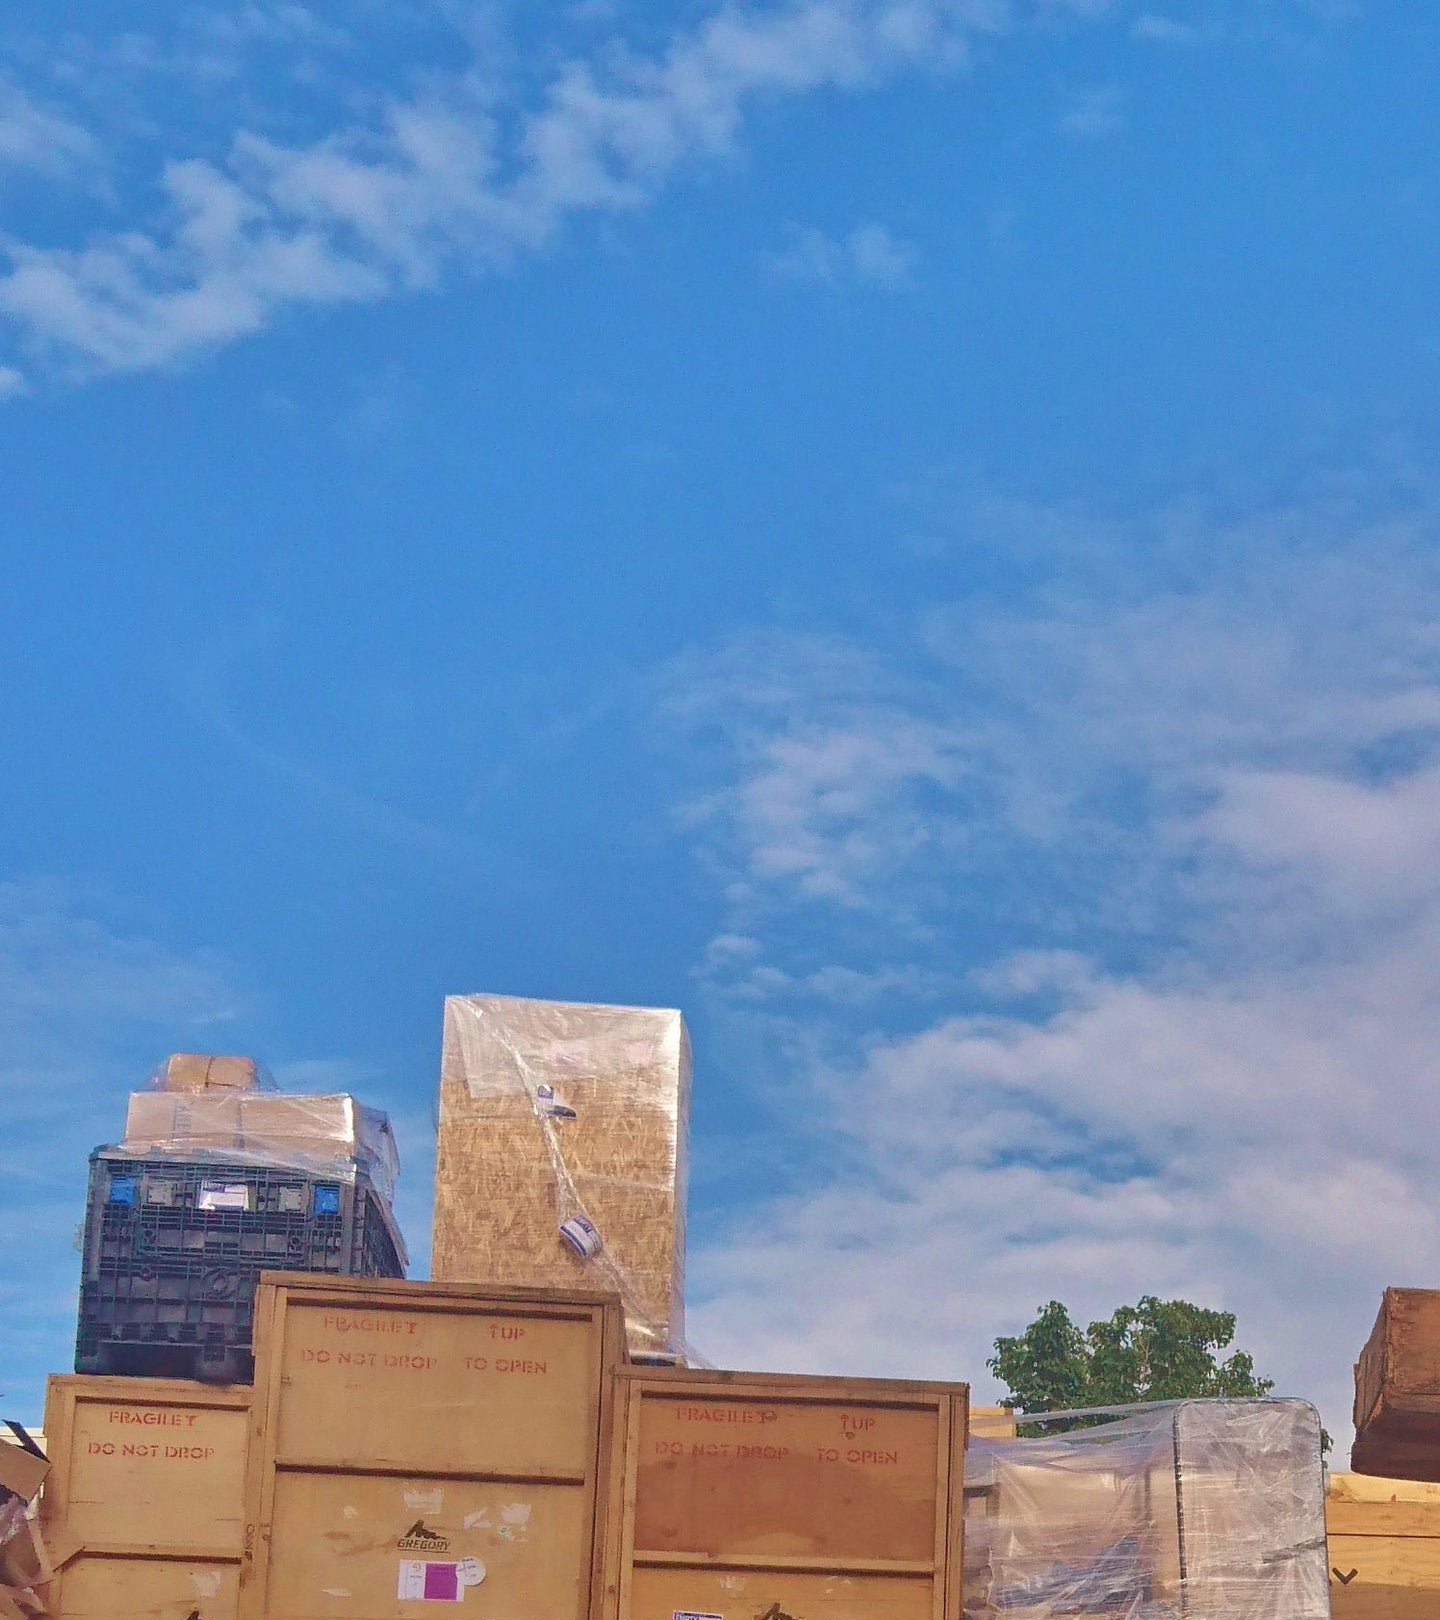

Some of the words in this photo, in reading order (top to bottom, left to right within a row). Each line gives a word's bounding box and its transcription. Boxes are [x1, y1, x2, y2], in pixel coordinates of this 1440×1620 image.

[500, 1328, 526, 1341] UP
[302, 1349, 332, 1365] DO
[338, 1351, 378, 1366] NOT
[384, 1354, 438, 1371] DROP
[464, 1356, 489, 1371] TO
[495, 1357, 548, 1375] OPEN
[110, 1411, 181, 1426] FRAGILE
[88, 1442, 115, 1456] DO
[122, 1443, 159, 1457] NOT
[165, 1445, 215, 1460] DROP
[817, 1448, 840, 1463] TO
[847, 1449, 898, 1465] OPEN
[397, 1537, 452, 1551] GREGORY
